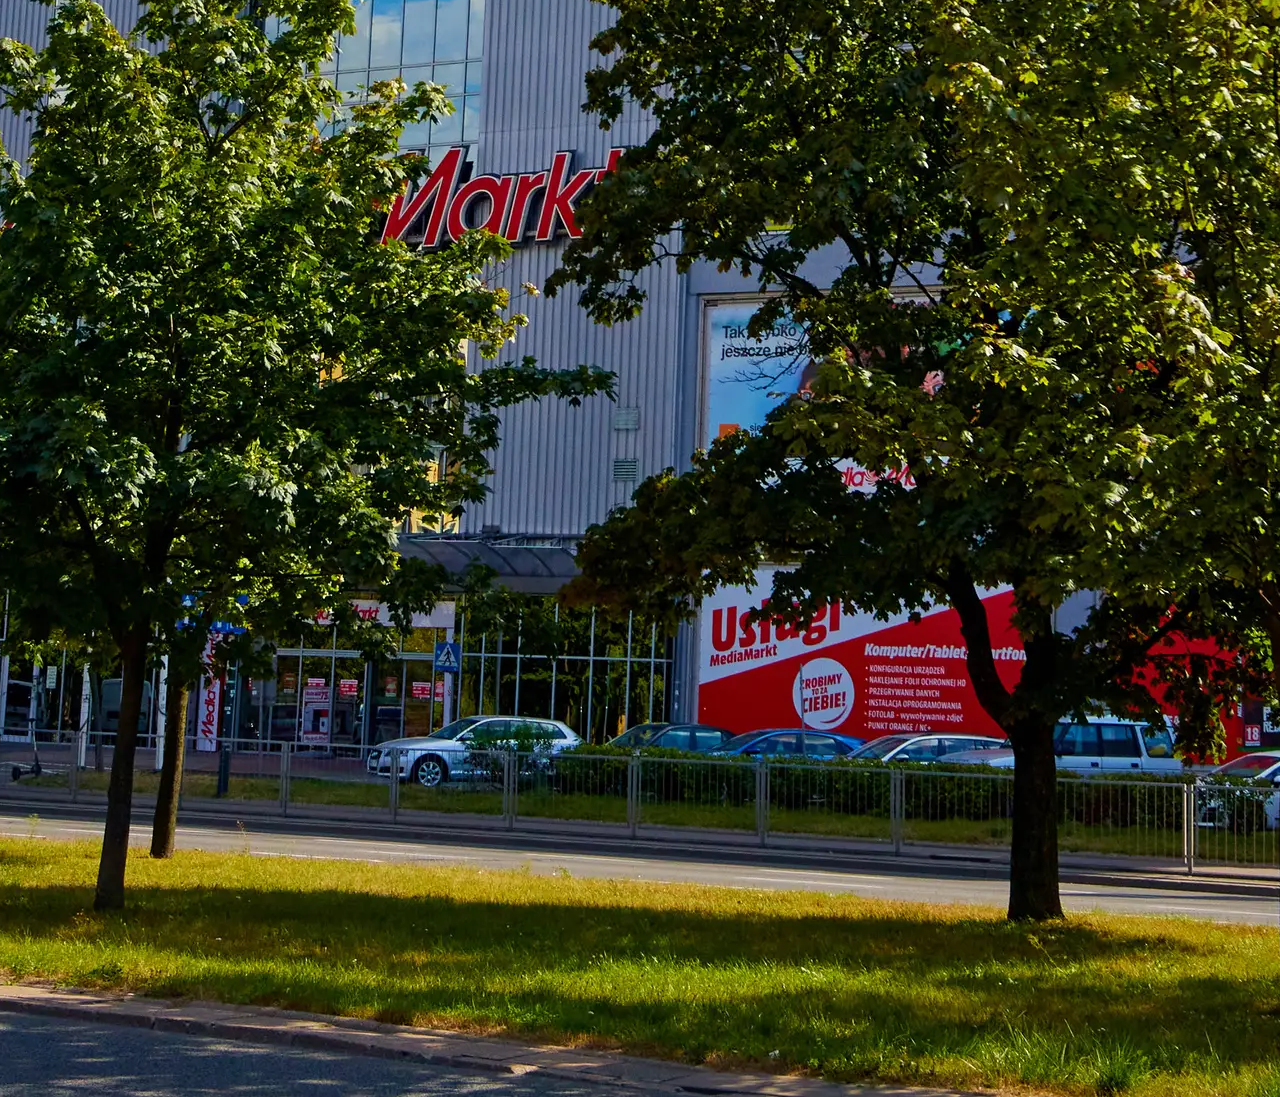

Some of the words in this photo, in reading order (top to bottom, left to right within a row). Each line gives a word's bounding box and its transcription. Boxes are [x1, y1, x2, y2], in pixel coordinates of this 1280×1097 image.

[722, 325, 746, 339] Tak
[709, 644, 778, 667] MediaMarkt
[869, 664, 913, 674] KONFIGURACJA
[869, 676, 903, 685] NAKLEJANIE
[904, 677, 920, 685] FOLII
[921, 678, 956, 687] OCHRONNEJ
[869, 687, 914, 697] PRZEGRYWANIE
[915, 689, 940, 698] DANYCH
[868, 698, 902, 708] INSTALACJA
[902, 700, 962, 710] OPROGRAMOWANIA
[868, 710, 895, 719] FOTOLAB
[868, 721, 888, 730] PUNKT
[889, 722, 913, 731] ORANGE
[1246, 727, 1259, 741] 18
